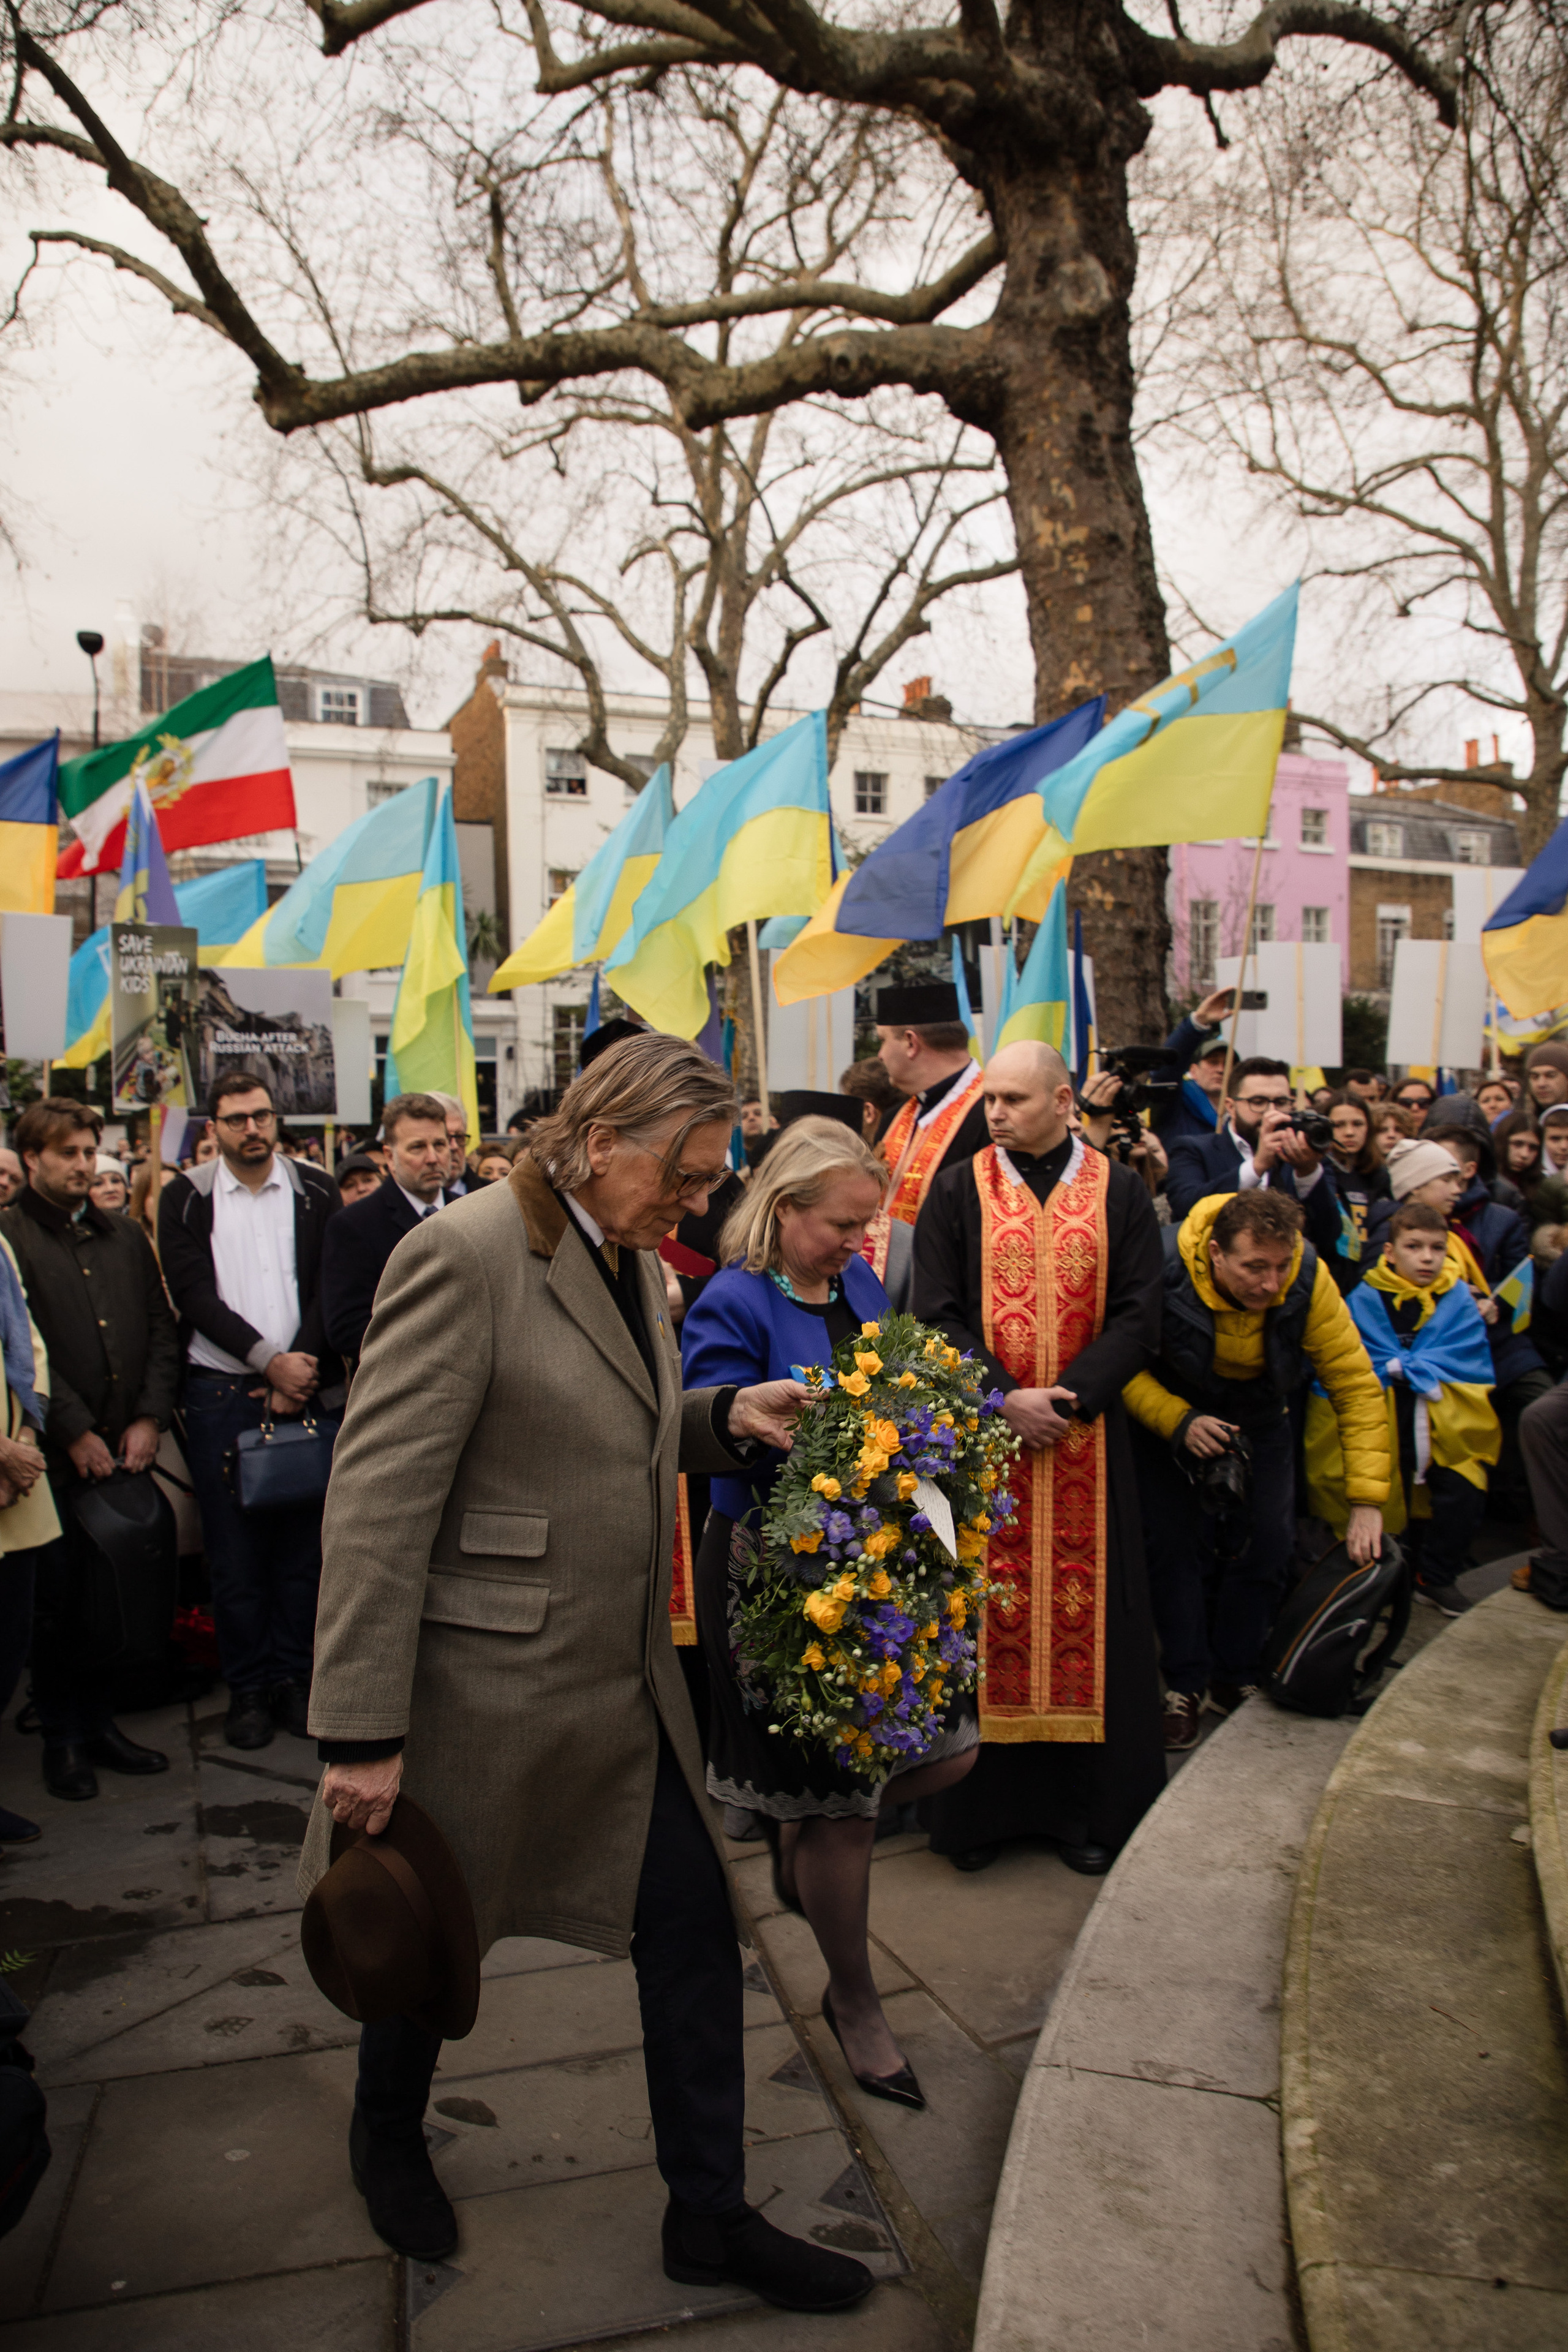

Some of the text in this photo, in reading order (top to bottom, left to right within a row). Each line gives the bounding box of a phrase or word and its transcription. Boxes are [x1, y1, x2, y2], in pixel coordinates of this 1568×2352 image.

[118, 933, 153, 954] SAVE
[119, 951, 189, 975] UKRAINIAN
[120, 975, 149, 993] KIDS
[216, 1030, 298, 1042] BUCHA AFTER
[208, 1042, 309, 1054] RUSSIAN ATTACK
